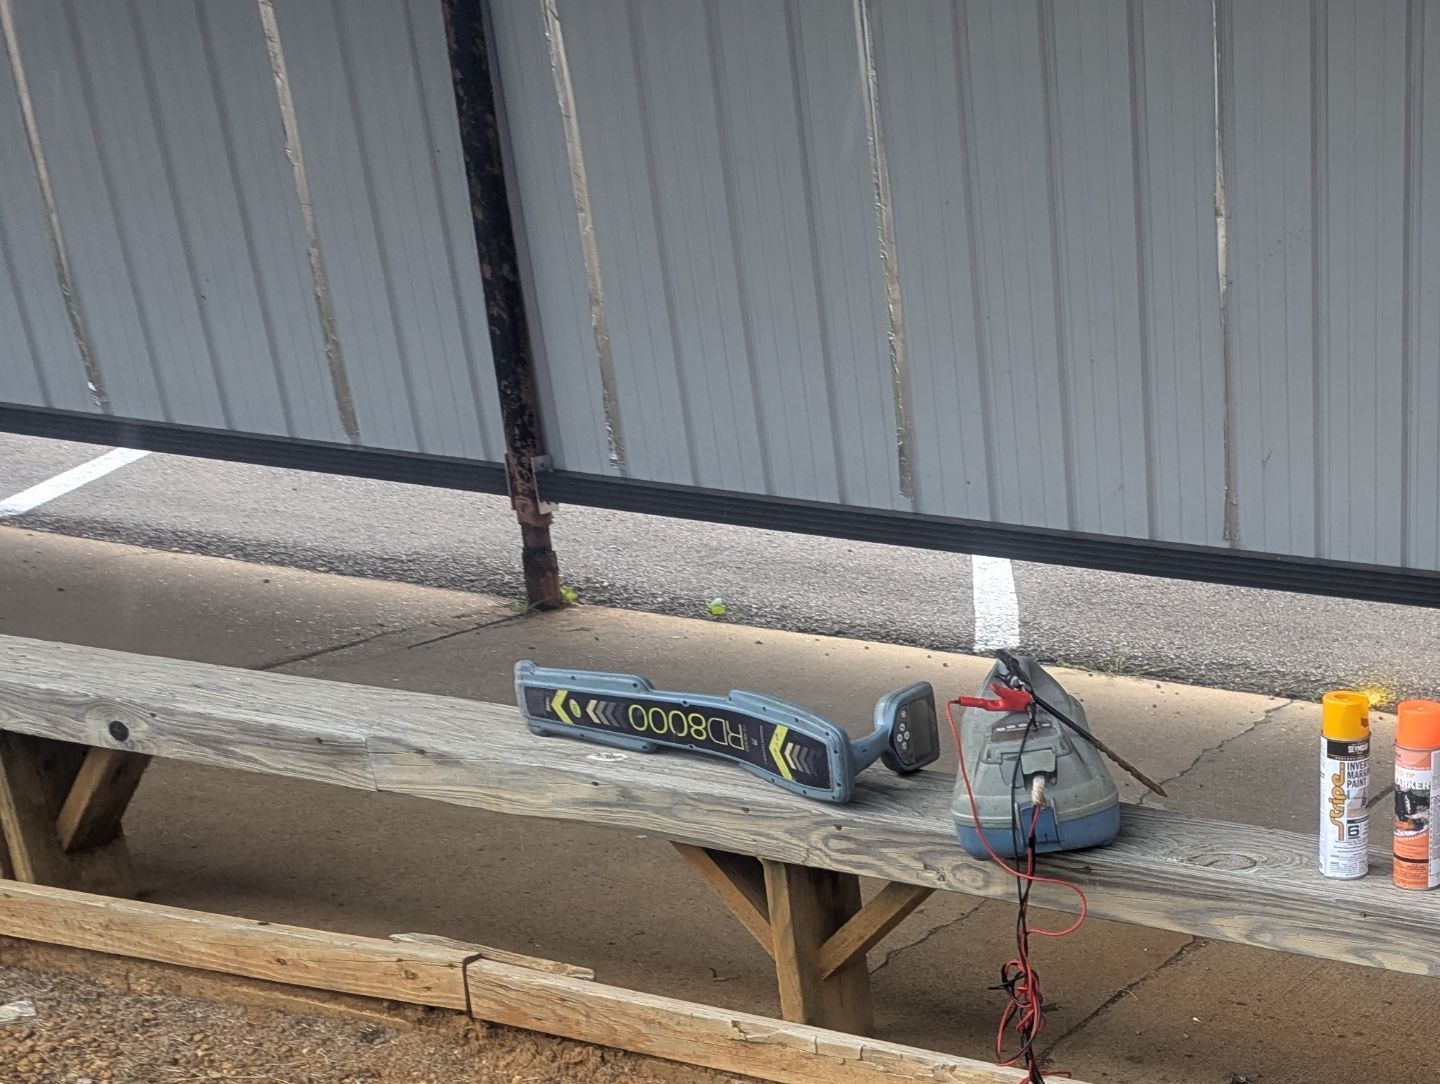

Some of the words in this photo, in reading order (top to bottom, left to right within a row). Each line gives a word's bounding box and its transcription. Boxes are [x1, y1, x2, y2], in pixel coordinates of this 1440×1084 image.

[628, 704, 745, 750] RD8000
[1328, 762, 1347, 841] stripe
[1347, 778, 1367, 788] PAINT
